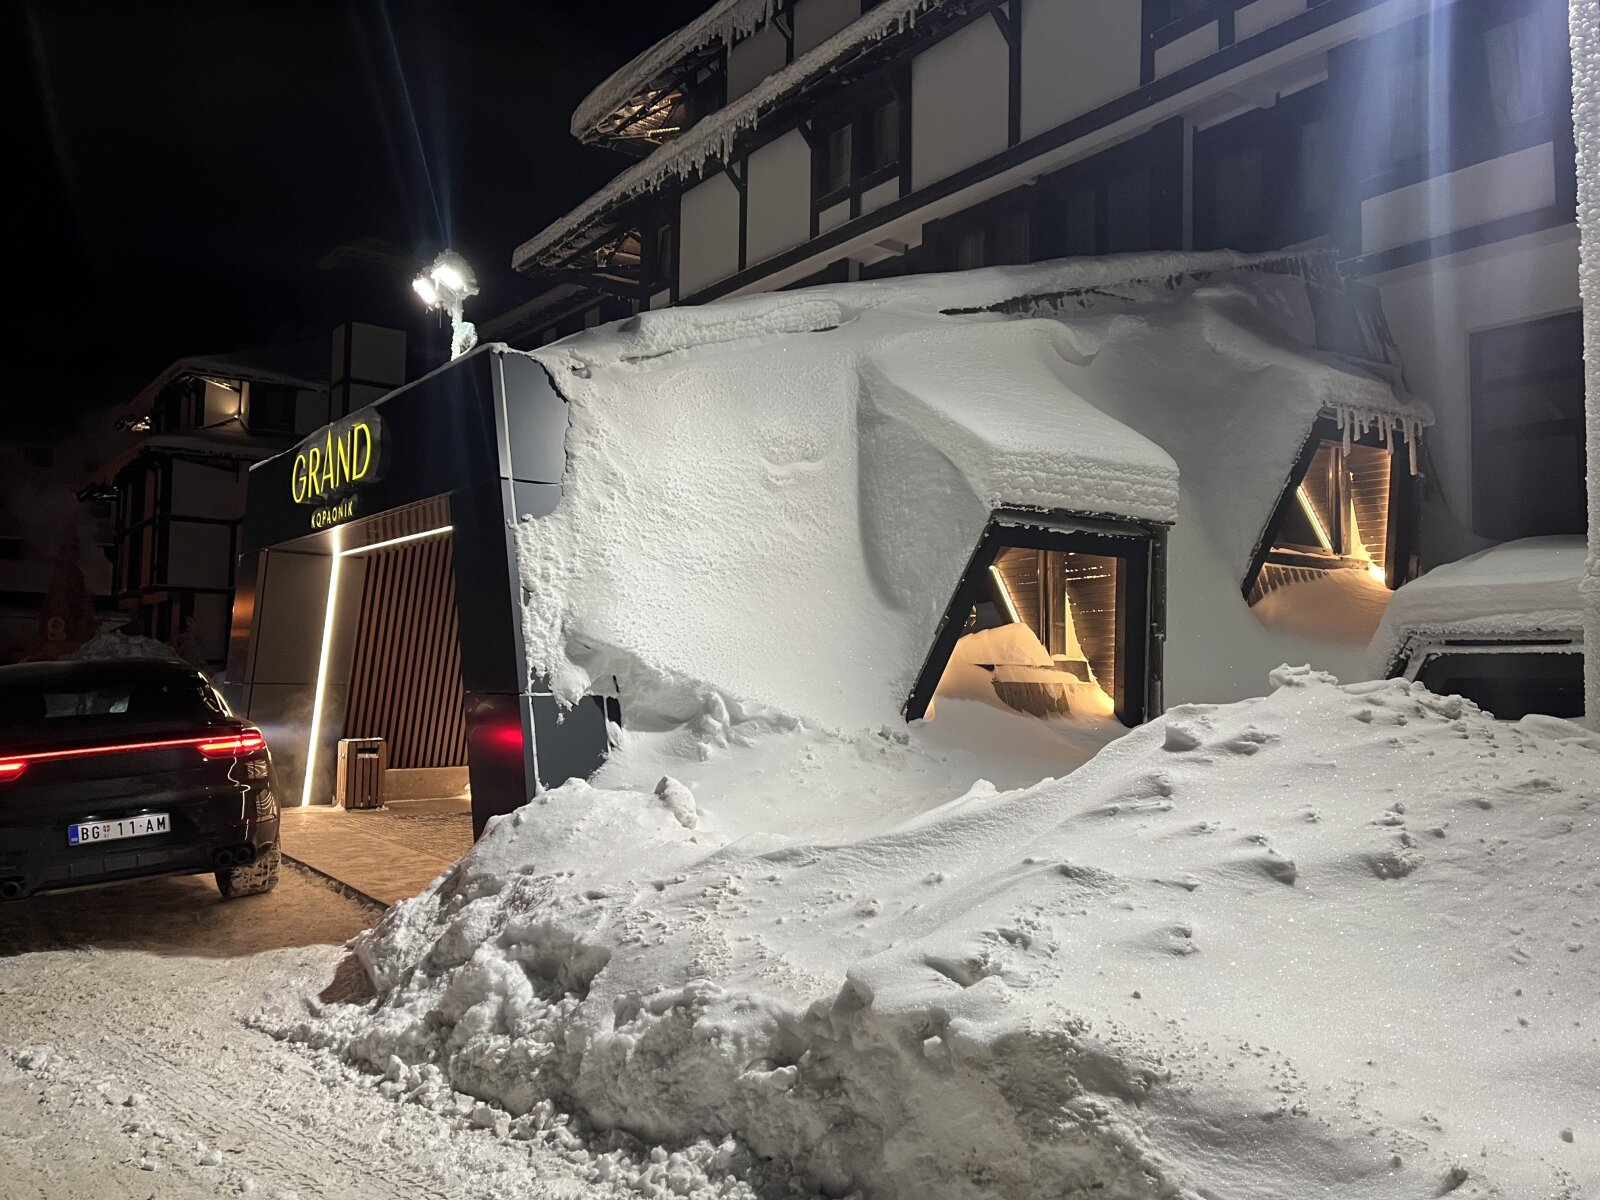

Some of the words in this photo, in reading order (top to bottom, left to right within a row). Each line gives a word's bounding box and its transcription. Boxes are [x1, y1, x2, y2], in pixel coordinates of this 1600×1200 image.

[292, 423, 371, 503] GRAND
[311, 501, 353, 528] KOPAONIK
[81, 826, 100, 840] BG
